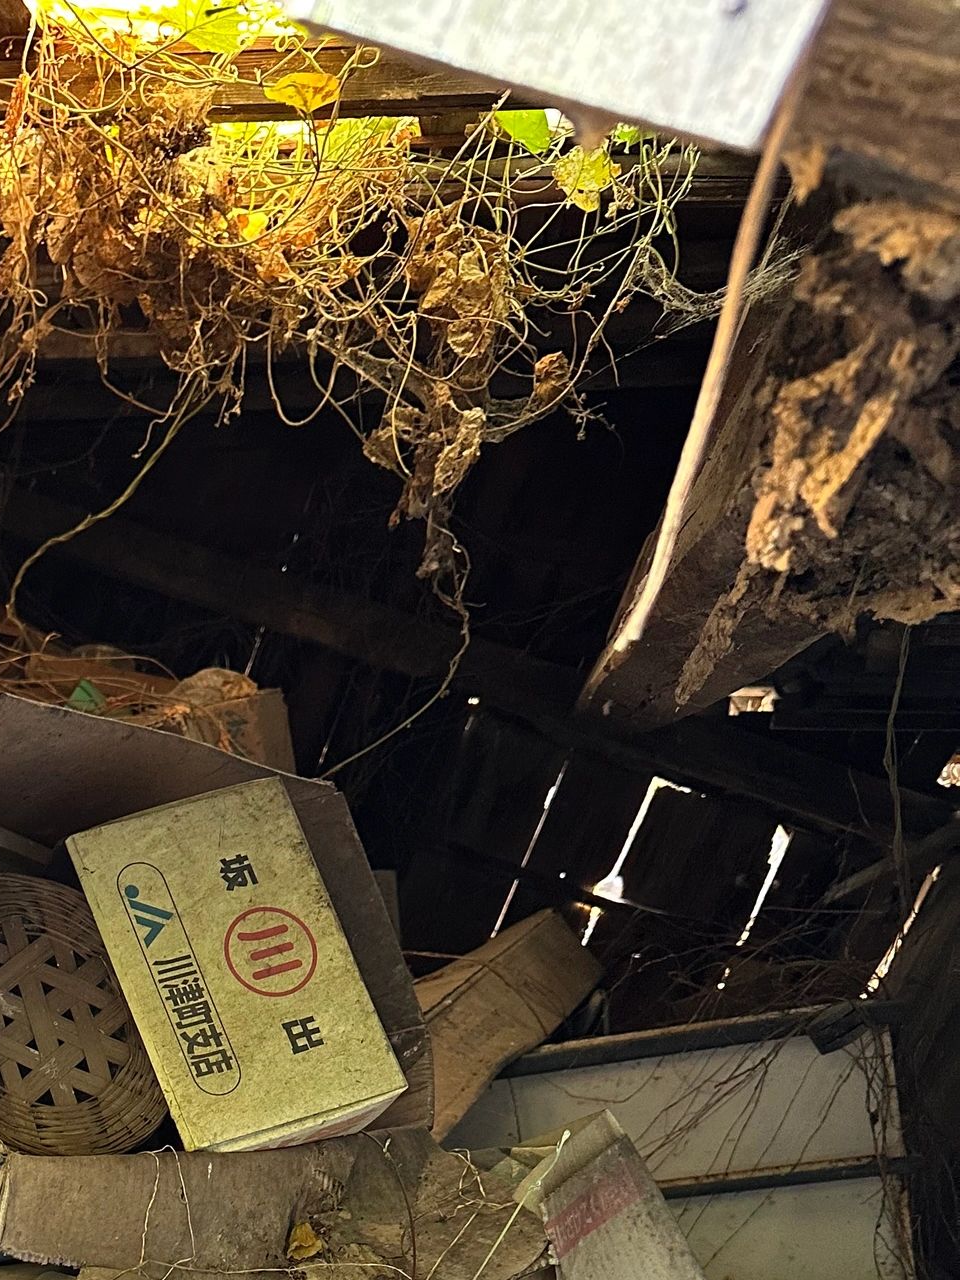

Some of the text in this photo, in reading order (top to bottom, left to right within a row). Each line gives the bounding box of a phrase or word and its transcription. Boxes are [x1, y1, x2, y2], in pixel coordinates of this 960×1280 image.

[153, 954, 236, 1078] 川津町支店
[220, 854, 258, 891] 坂
[282, 1016, 324, 1055] 出
